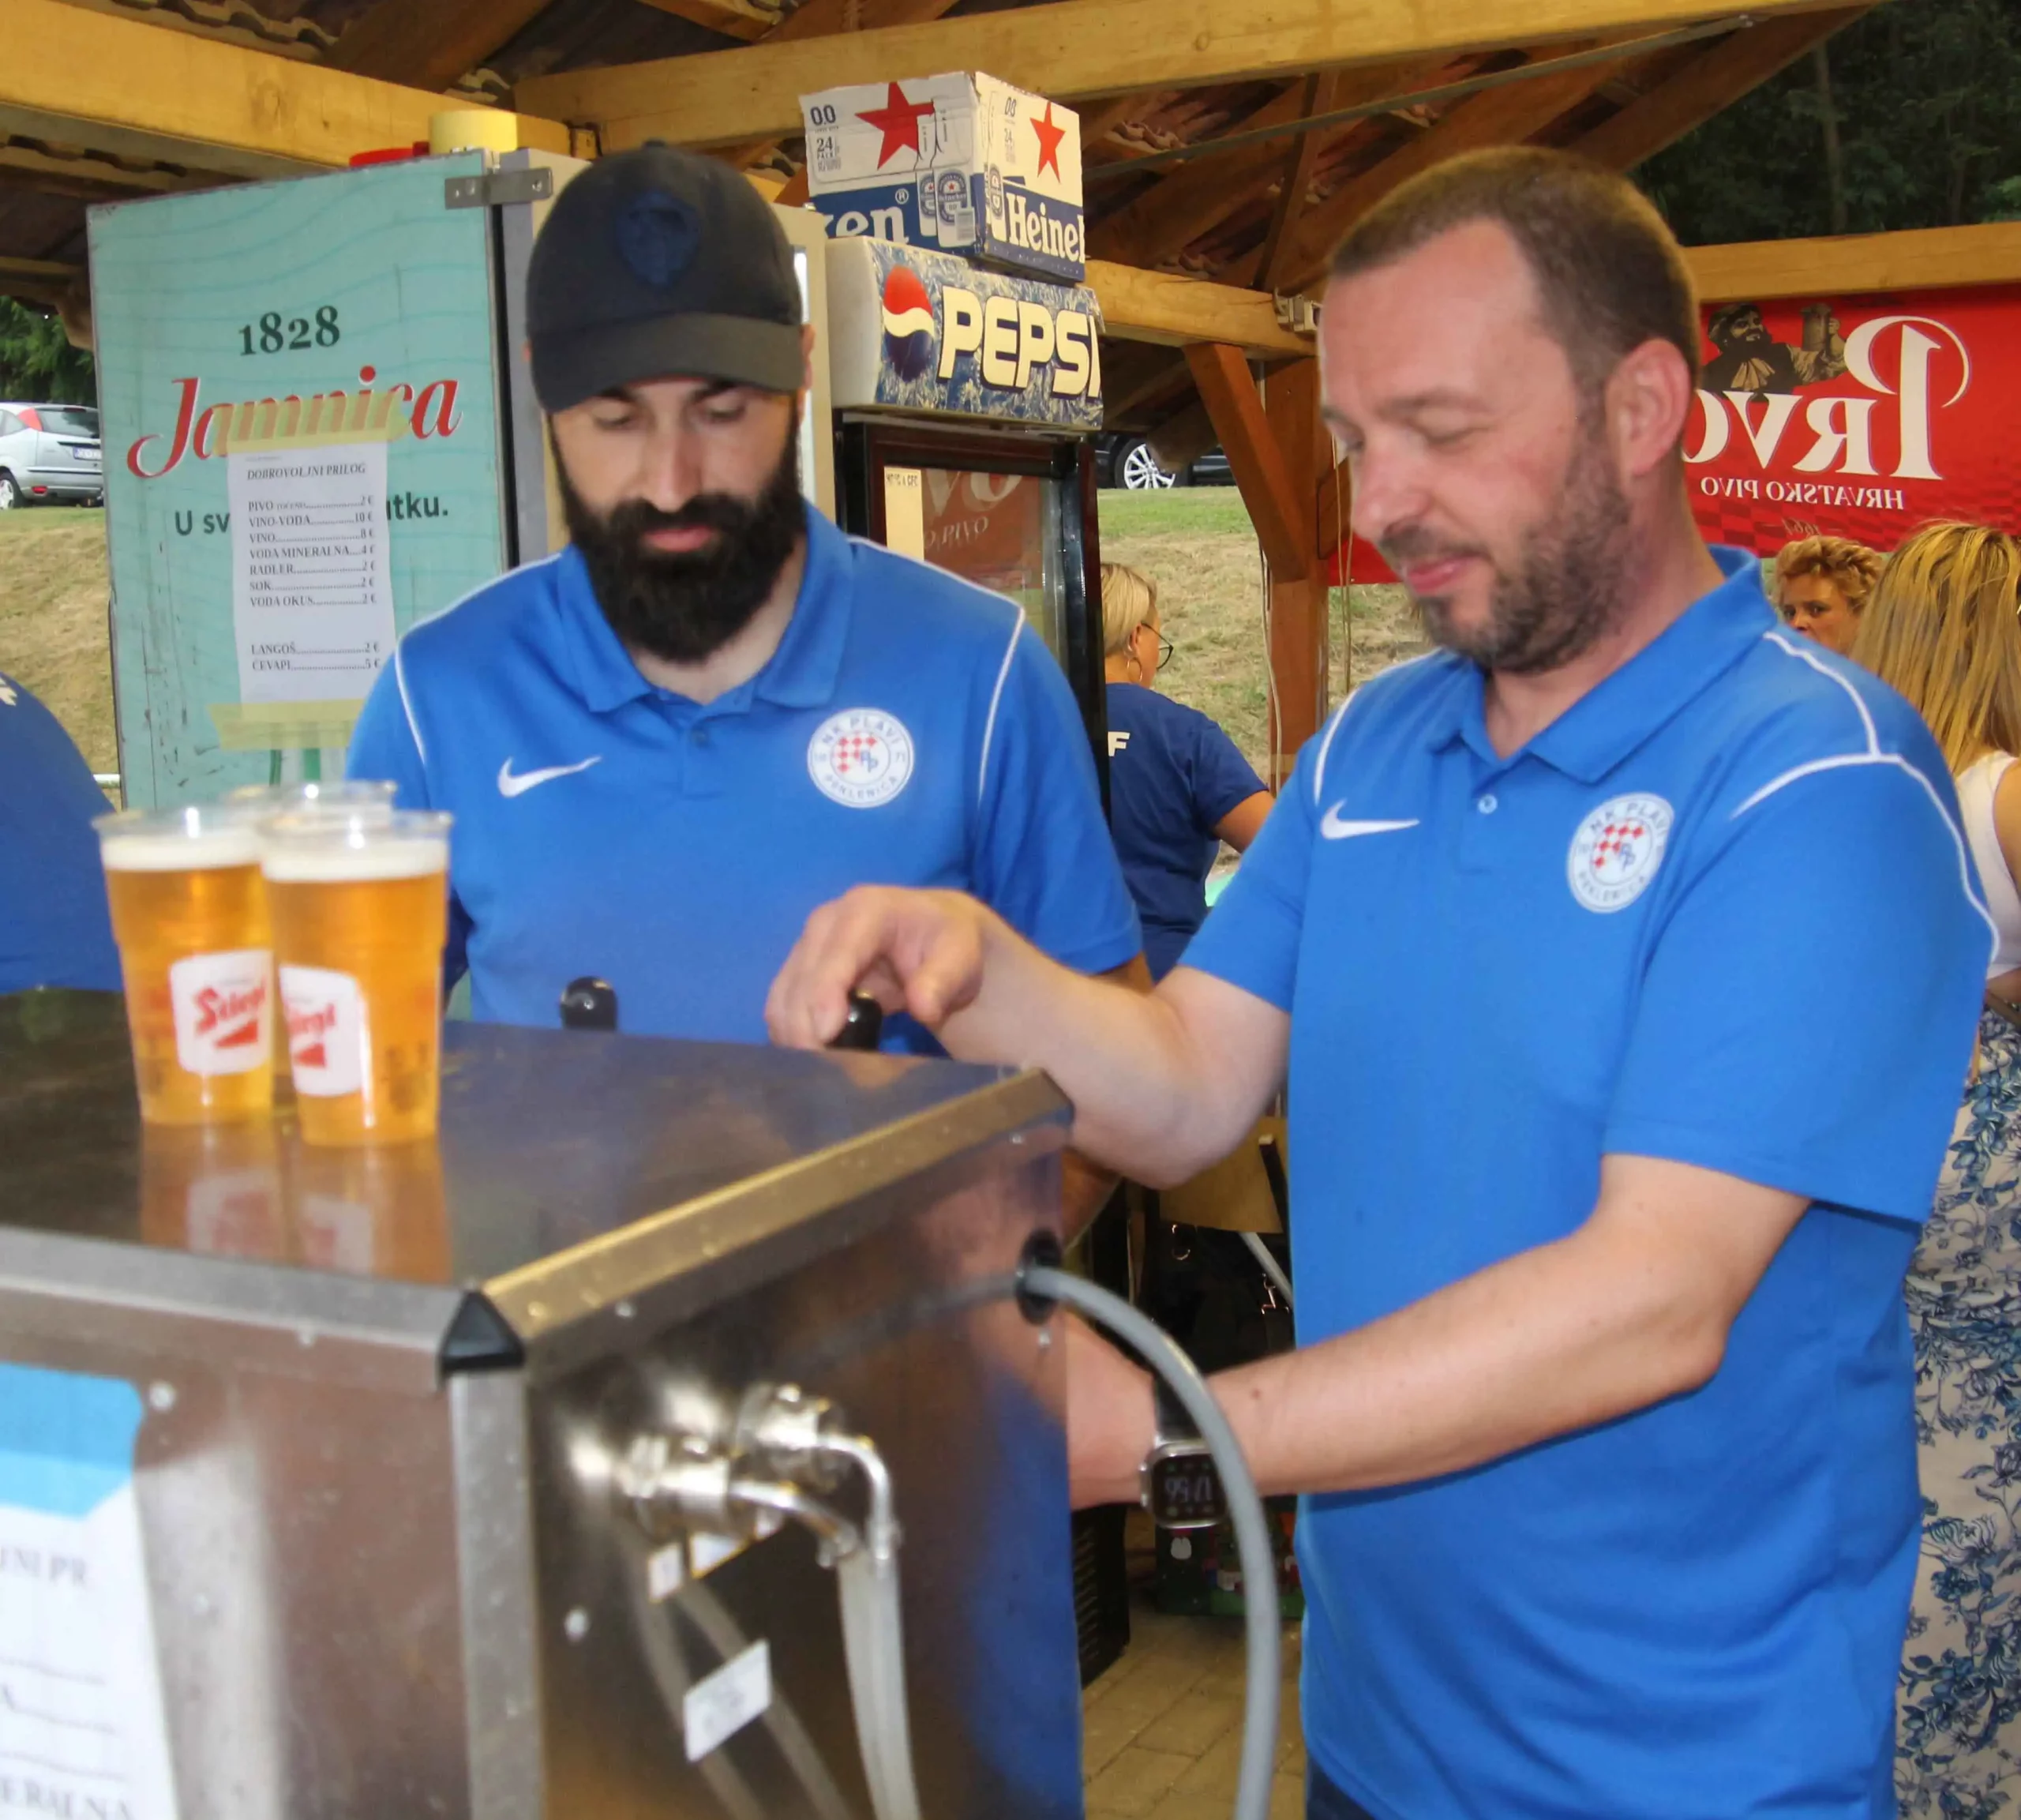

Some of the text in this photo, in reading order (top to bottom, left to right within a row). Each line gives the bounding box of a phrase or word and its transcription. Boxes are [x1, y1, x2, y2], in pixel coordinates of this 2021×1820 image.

[810, 105, 836, 126] 0.0
[816, 137, 834, 152] 24
[238, 305, 341, 356] 1828
[937, 285, 1102, 398] PEPSI
[247, 462, 366, 481] DOBROVOLJNI PRILOG
[248, 501, 274, 512] PIVO
[174, 509, 193, 536] U
[249, 515, 311, 528] VINO-VODA
[355, 512, 366, 523] 10
[249, 532, 276, 544] VINO
[249, 548, 280, 560] VODA
[281, 545, 350, 558] MINERALNA
[360, 545, 367, 555] 4
[249, 563, 294, 576] RADLER
[362, 560, 368, 572] 2
[249, 580, 272, 591] SOK
[360, 577, 366, 588] 2
[249, 596, 282, 608] VODA
[283, 595, 313, 606] OKUS
[362, 594, 368, 605] 2
[251, 640, 296, 655] LANGOŠ
[365, 642, 370, 654] 2
[365, 659, 371, 670] 5
